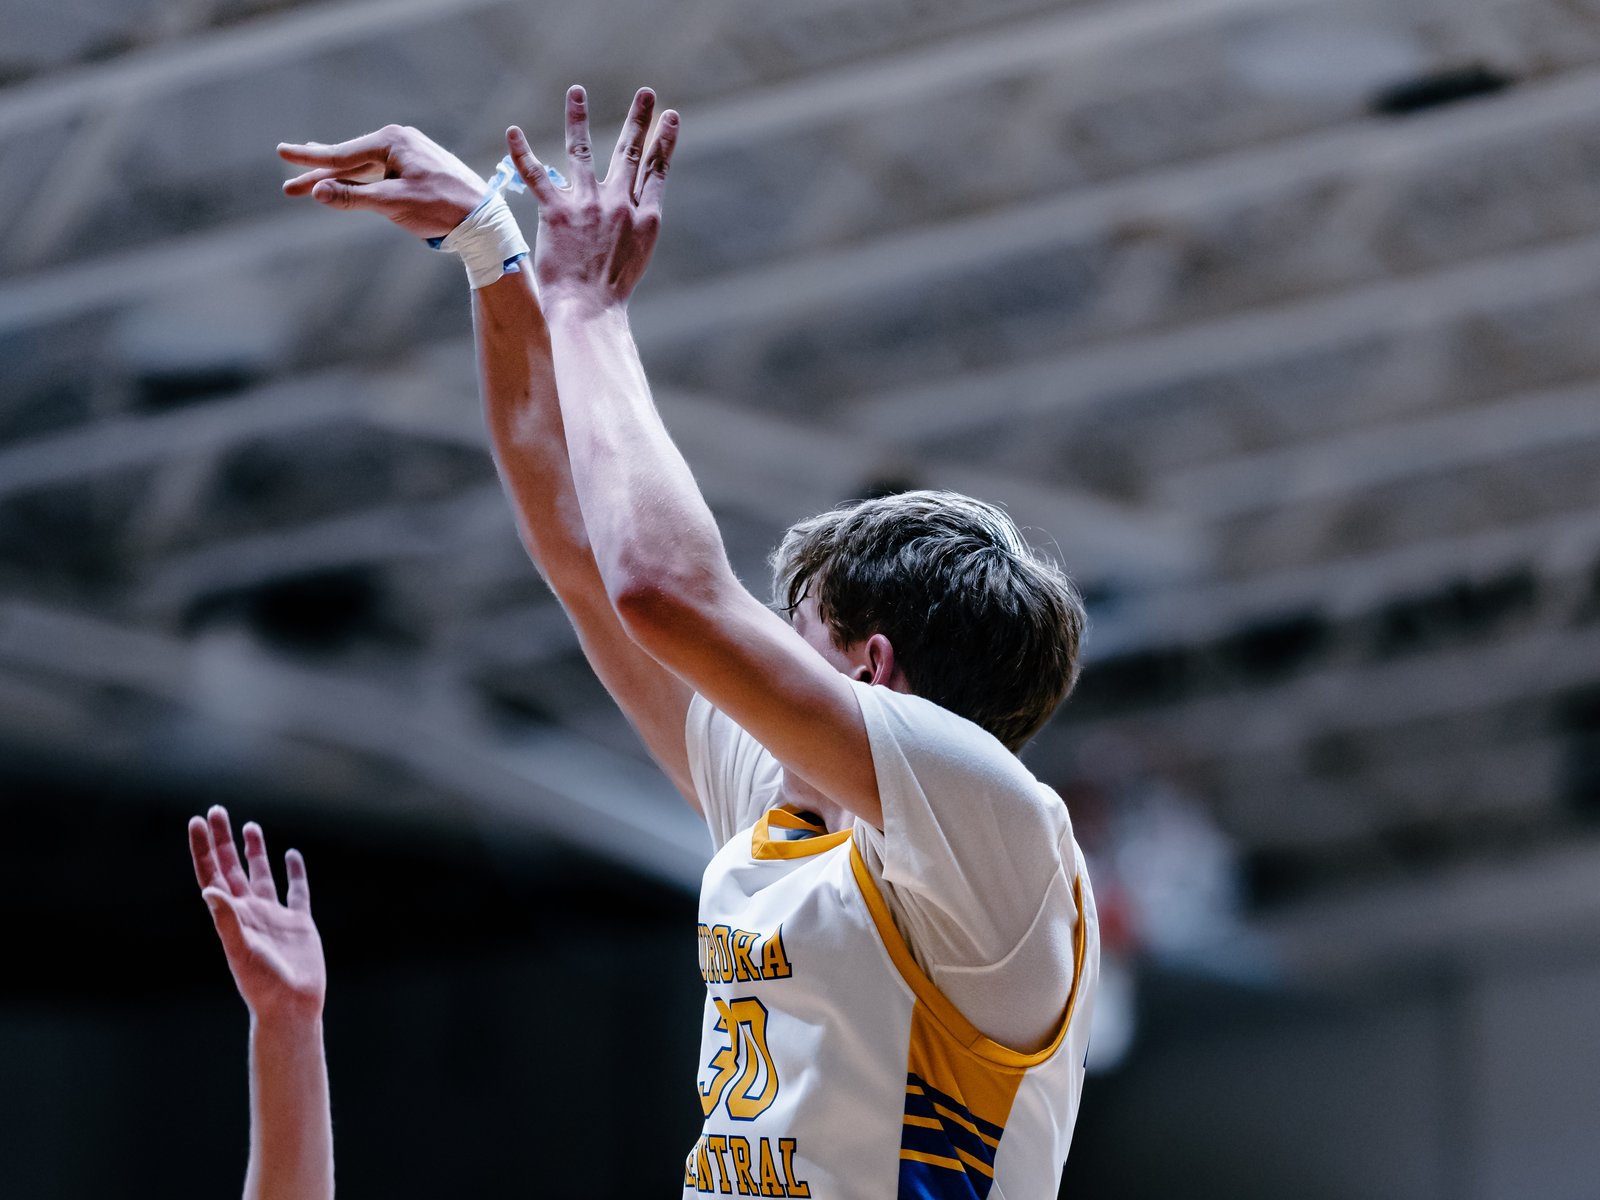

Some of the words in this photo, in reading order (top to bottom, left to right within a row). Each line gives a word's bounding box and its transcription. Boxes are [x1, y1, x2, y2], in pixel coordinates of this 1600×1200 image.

[698, 922, 792, 984] URORA
[699, 996, 779, 1121] 30
[685, 1133, 811, 1199] ENTRAL
